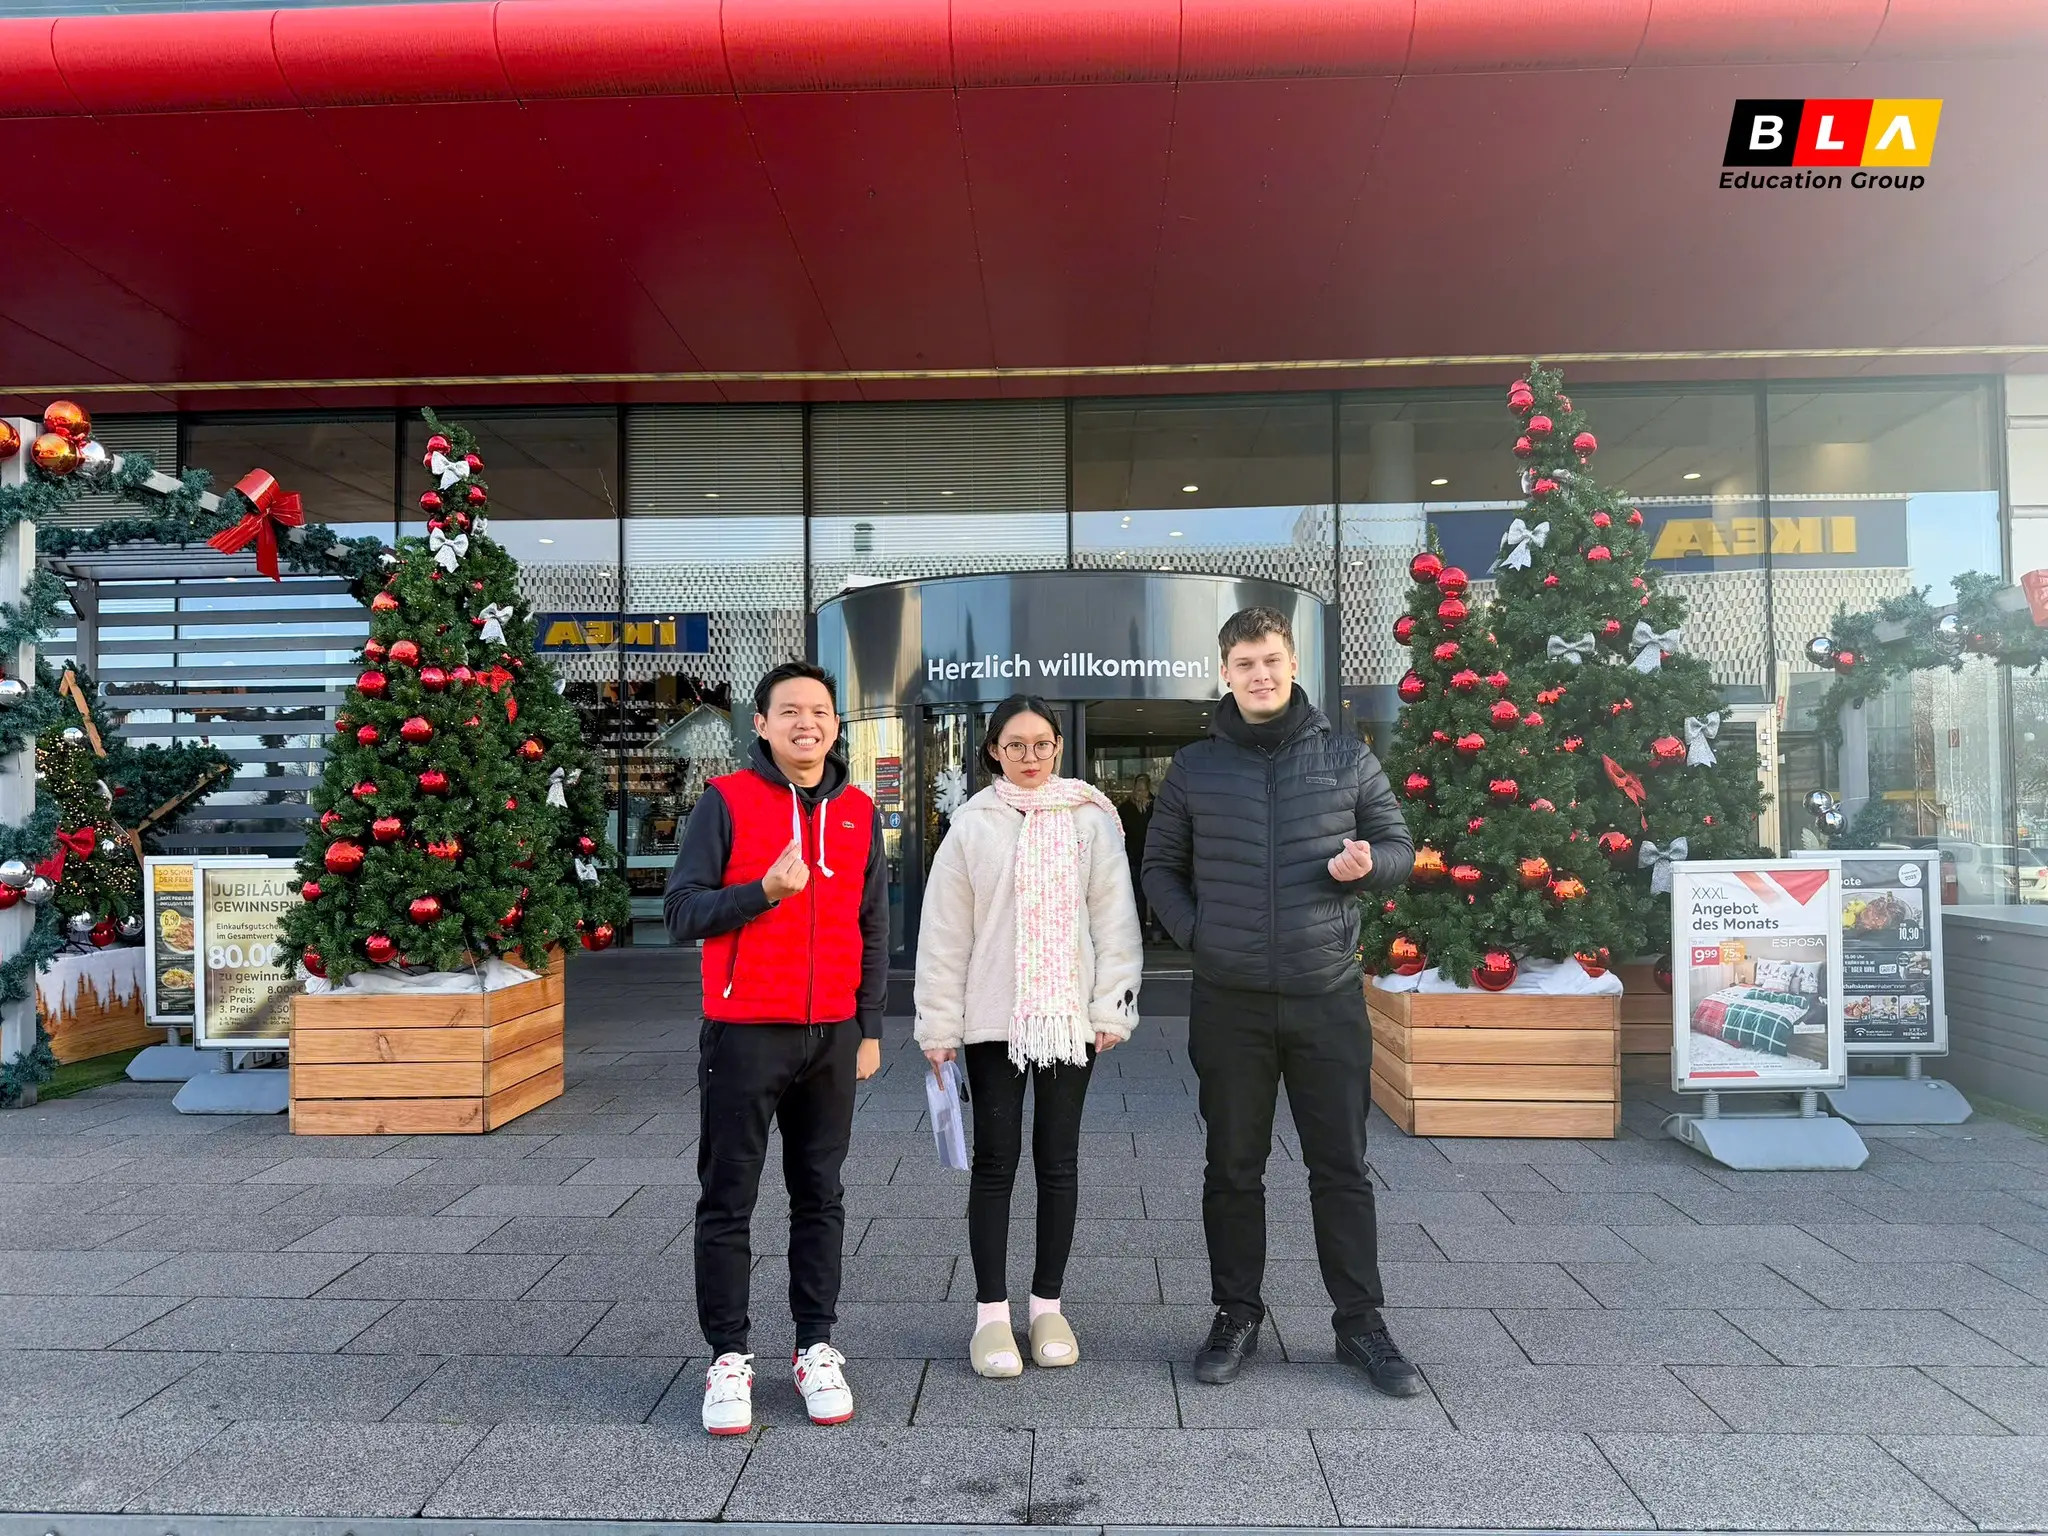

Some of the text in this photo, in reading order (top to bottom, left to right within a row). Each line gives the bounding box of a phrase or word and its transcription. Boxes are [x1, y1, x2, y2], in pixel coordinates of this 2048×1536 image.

[928, 652, 1210, 681] Herzlich willkommen!
[1841, 878, 1861, 886] ote
[1692, 887, 1728, 899] XXXL
[1692, 903, 1759, 917] Angebot
[1692, 917, 1779, 930] des Monats
[1772, 938, 1824, 947] ESPOSA
[219, 973, 232, 981] zu
[220, 986, 226, 994] 1.
[229, 986, 254, 994] Preis:
[220, 996, 227, 1004] 2.
[230, 996, 255, 1004] Preis:
